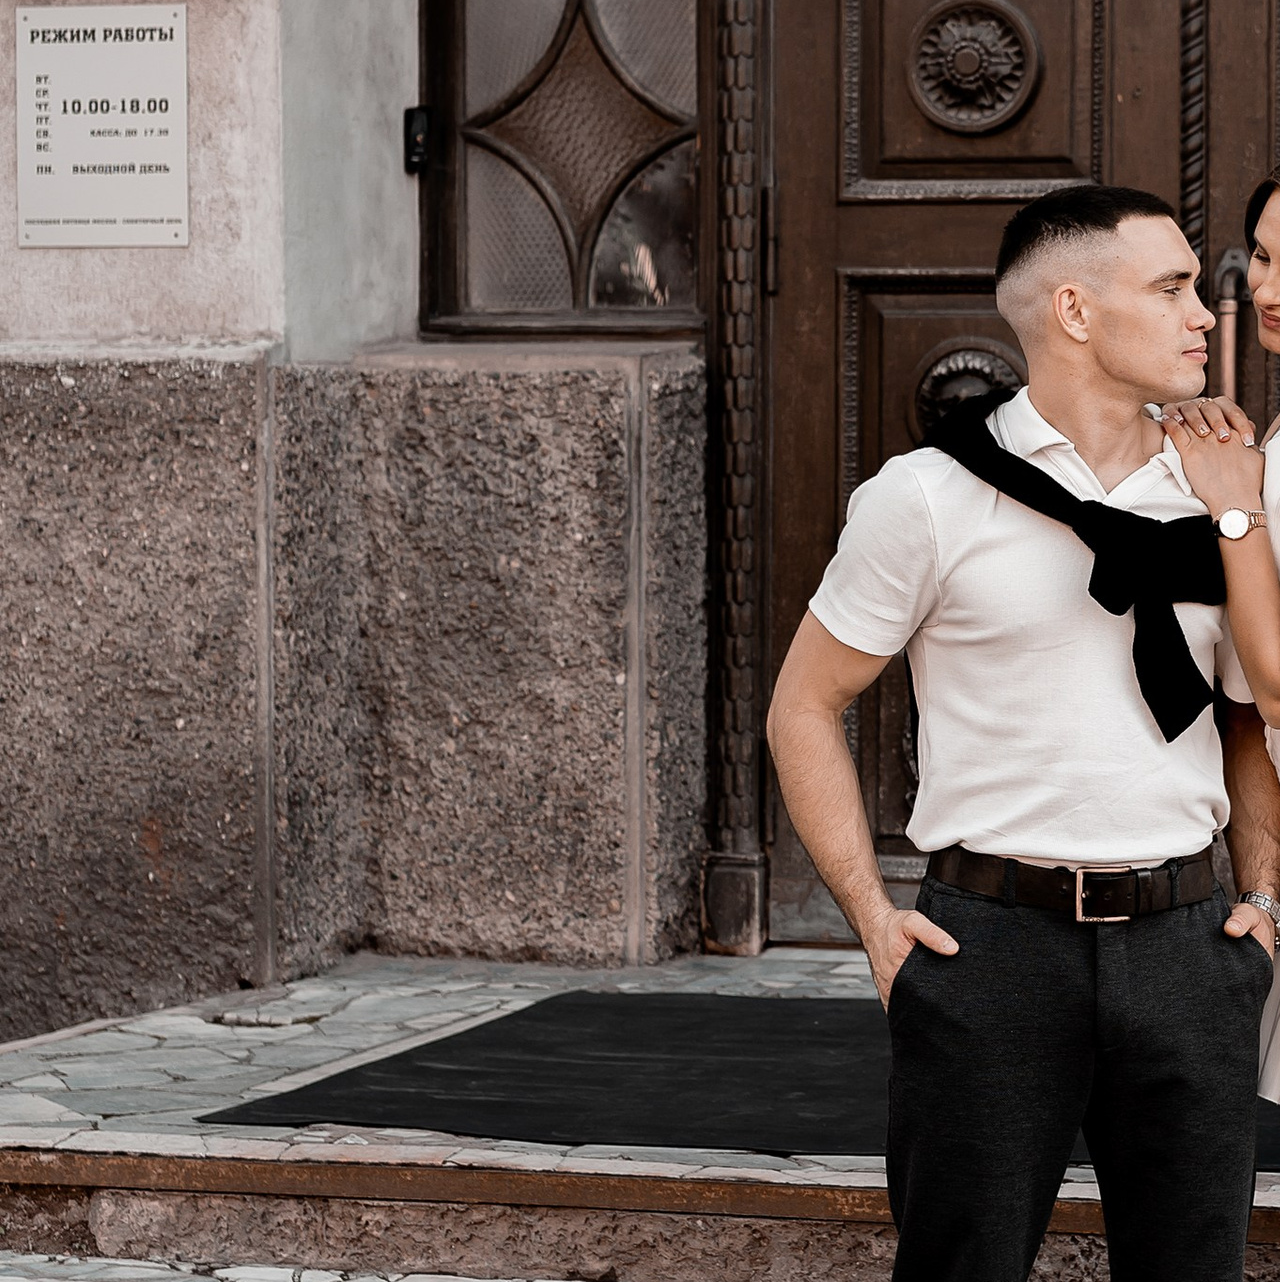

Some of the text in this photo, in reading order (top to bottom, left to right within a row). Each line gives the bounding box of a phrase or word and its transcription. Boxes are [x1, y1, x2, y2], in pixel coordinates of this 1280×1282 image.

[30, 26, 174, 44] РЕЖИМ РАБОТЫ
[61, 98, 169, 115] 10.00-18.00
[72, 163, 136, 175] ВЫХОДНОЙ
[139, 163, 170, 175] ДЕНЬ
